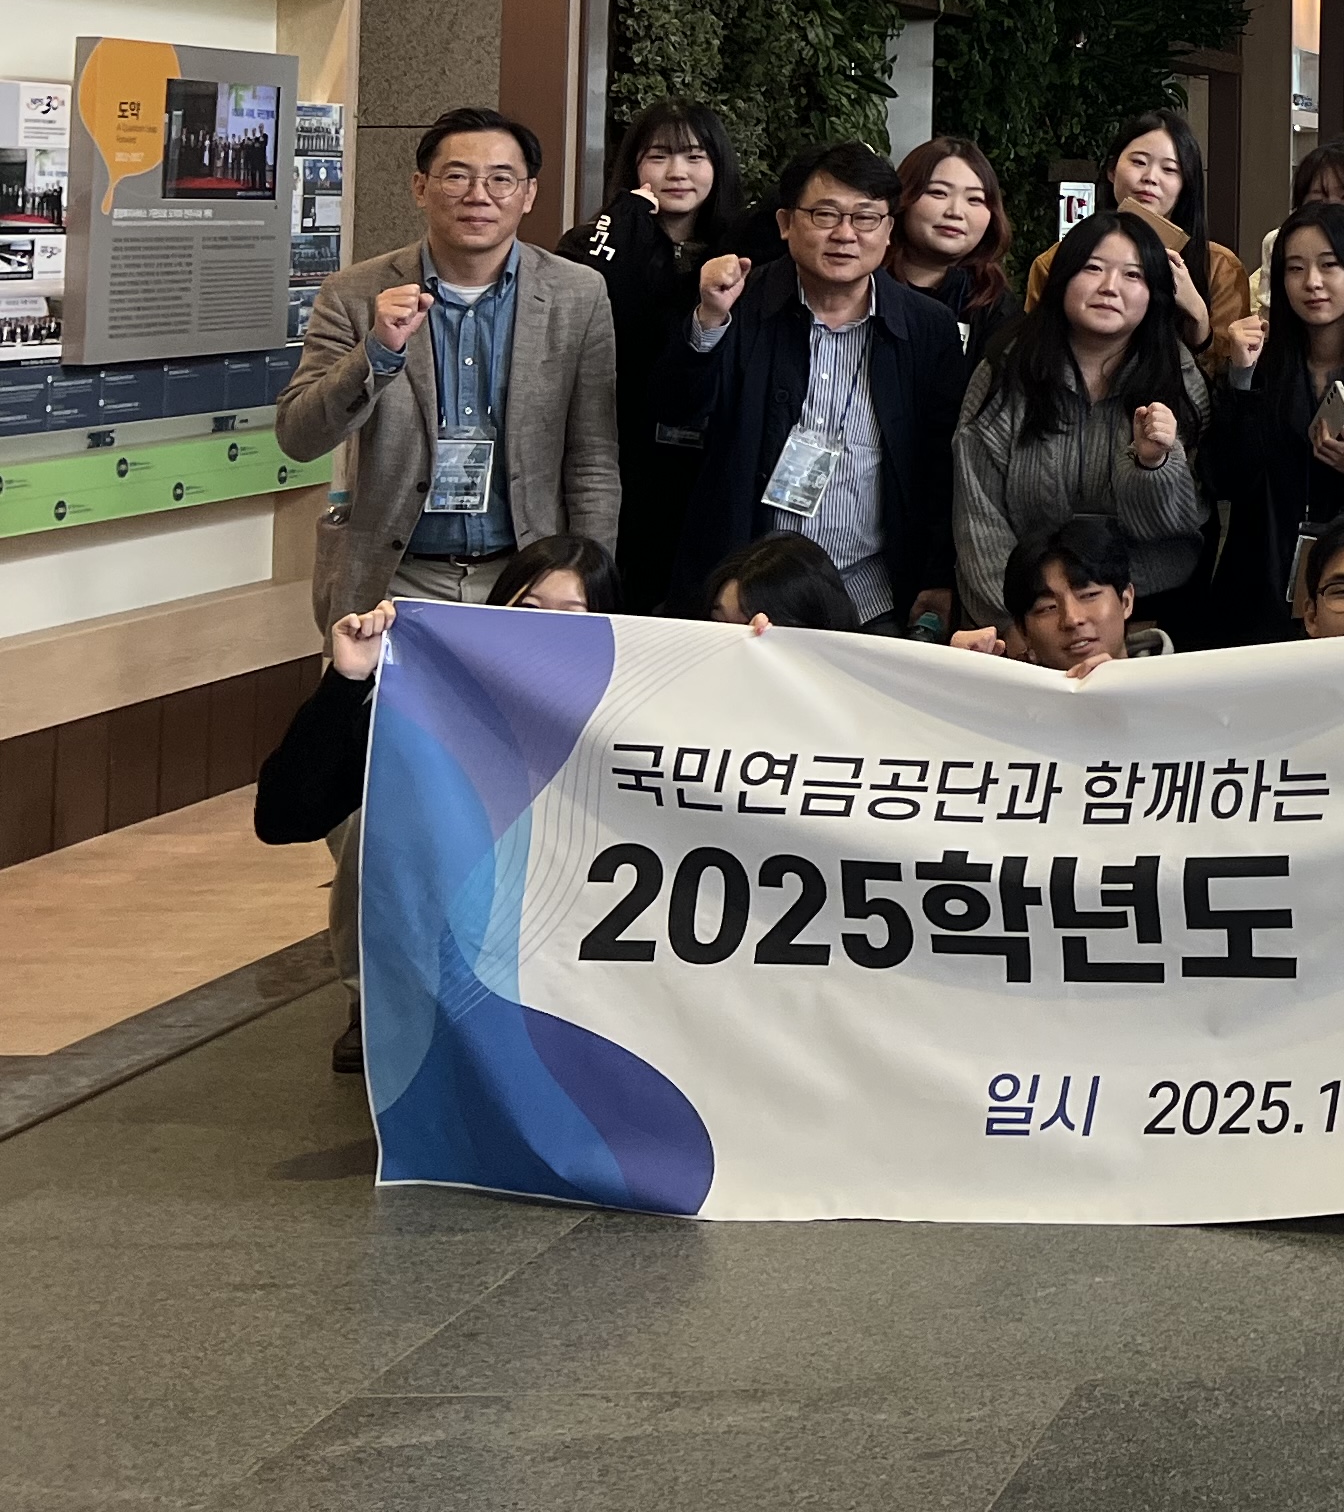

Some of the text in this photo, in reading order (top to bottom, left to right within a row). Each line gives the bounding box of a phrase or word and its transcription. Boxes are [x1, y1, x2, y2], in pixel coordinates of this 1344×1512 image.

[117, 101, 141, 120] 도약
[611, 742, 1331, 825] 국민연금공단과 함께하는
[578, 841, 1298, 984] 2025학년도
[985, 1072, 1101, 1138] 일시
